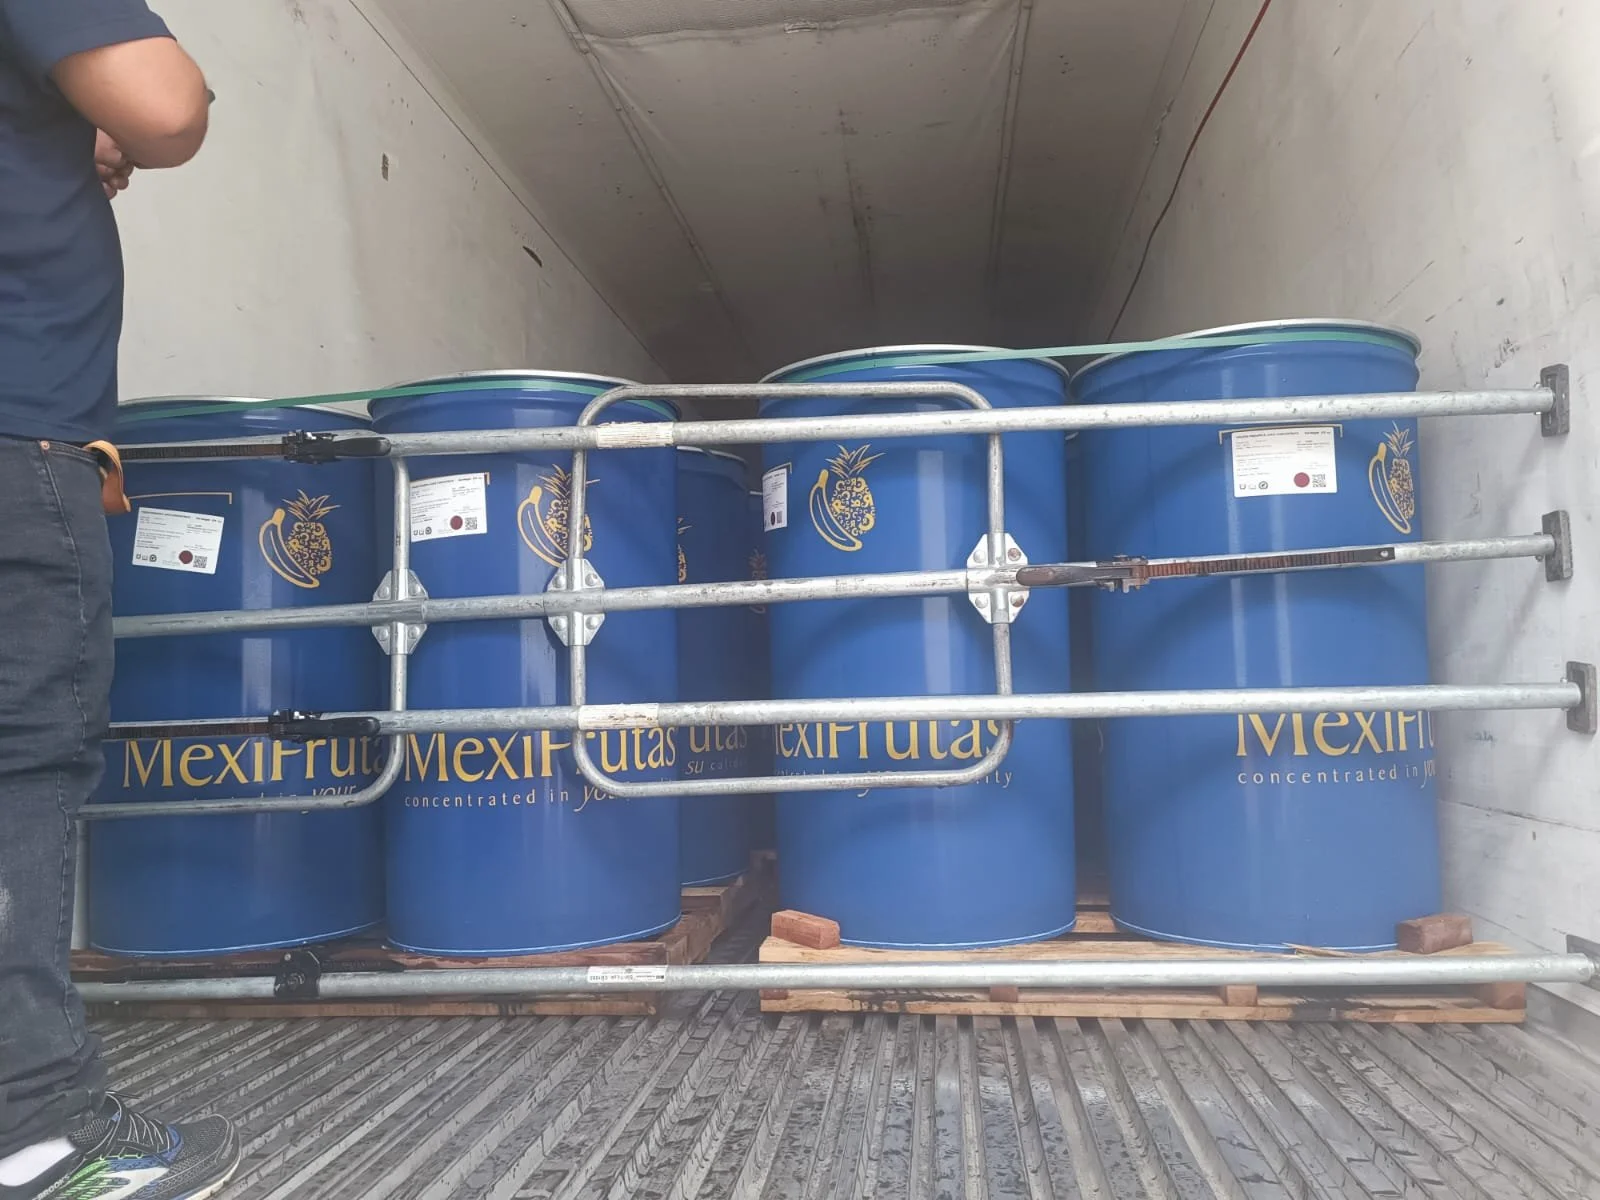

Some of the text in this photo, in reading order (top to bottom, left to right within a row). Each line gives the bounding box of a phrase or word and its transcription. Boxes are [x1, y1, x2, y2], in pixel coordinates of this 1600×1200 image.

[405, 727, 676, 782] MexiFutas
[685, 760, 704, 775] su
[1238, 763, 1397, 785] concentrated
[1405, 764, 1418, 779] in
[404, 788, 536, 808] concentrated
[550, 788, 569, 803] in
